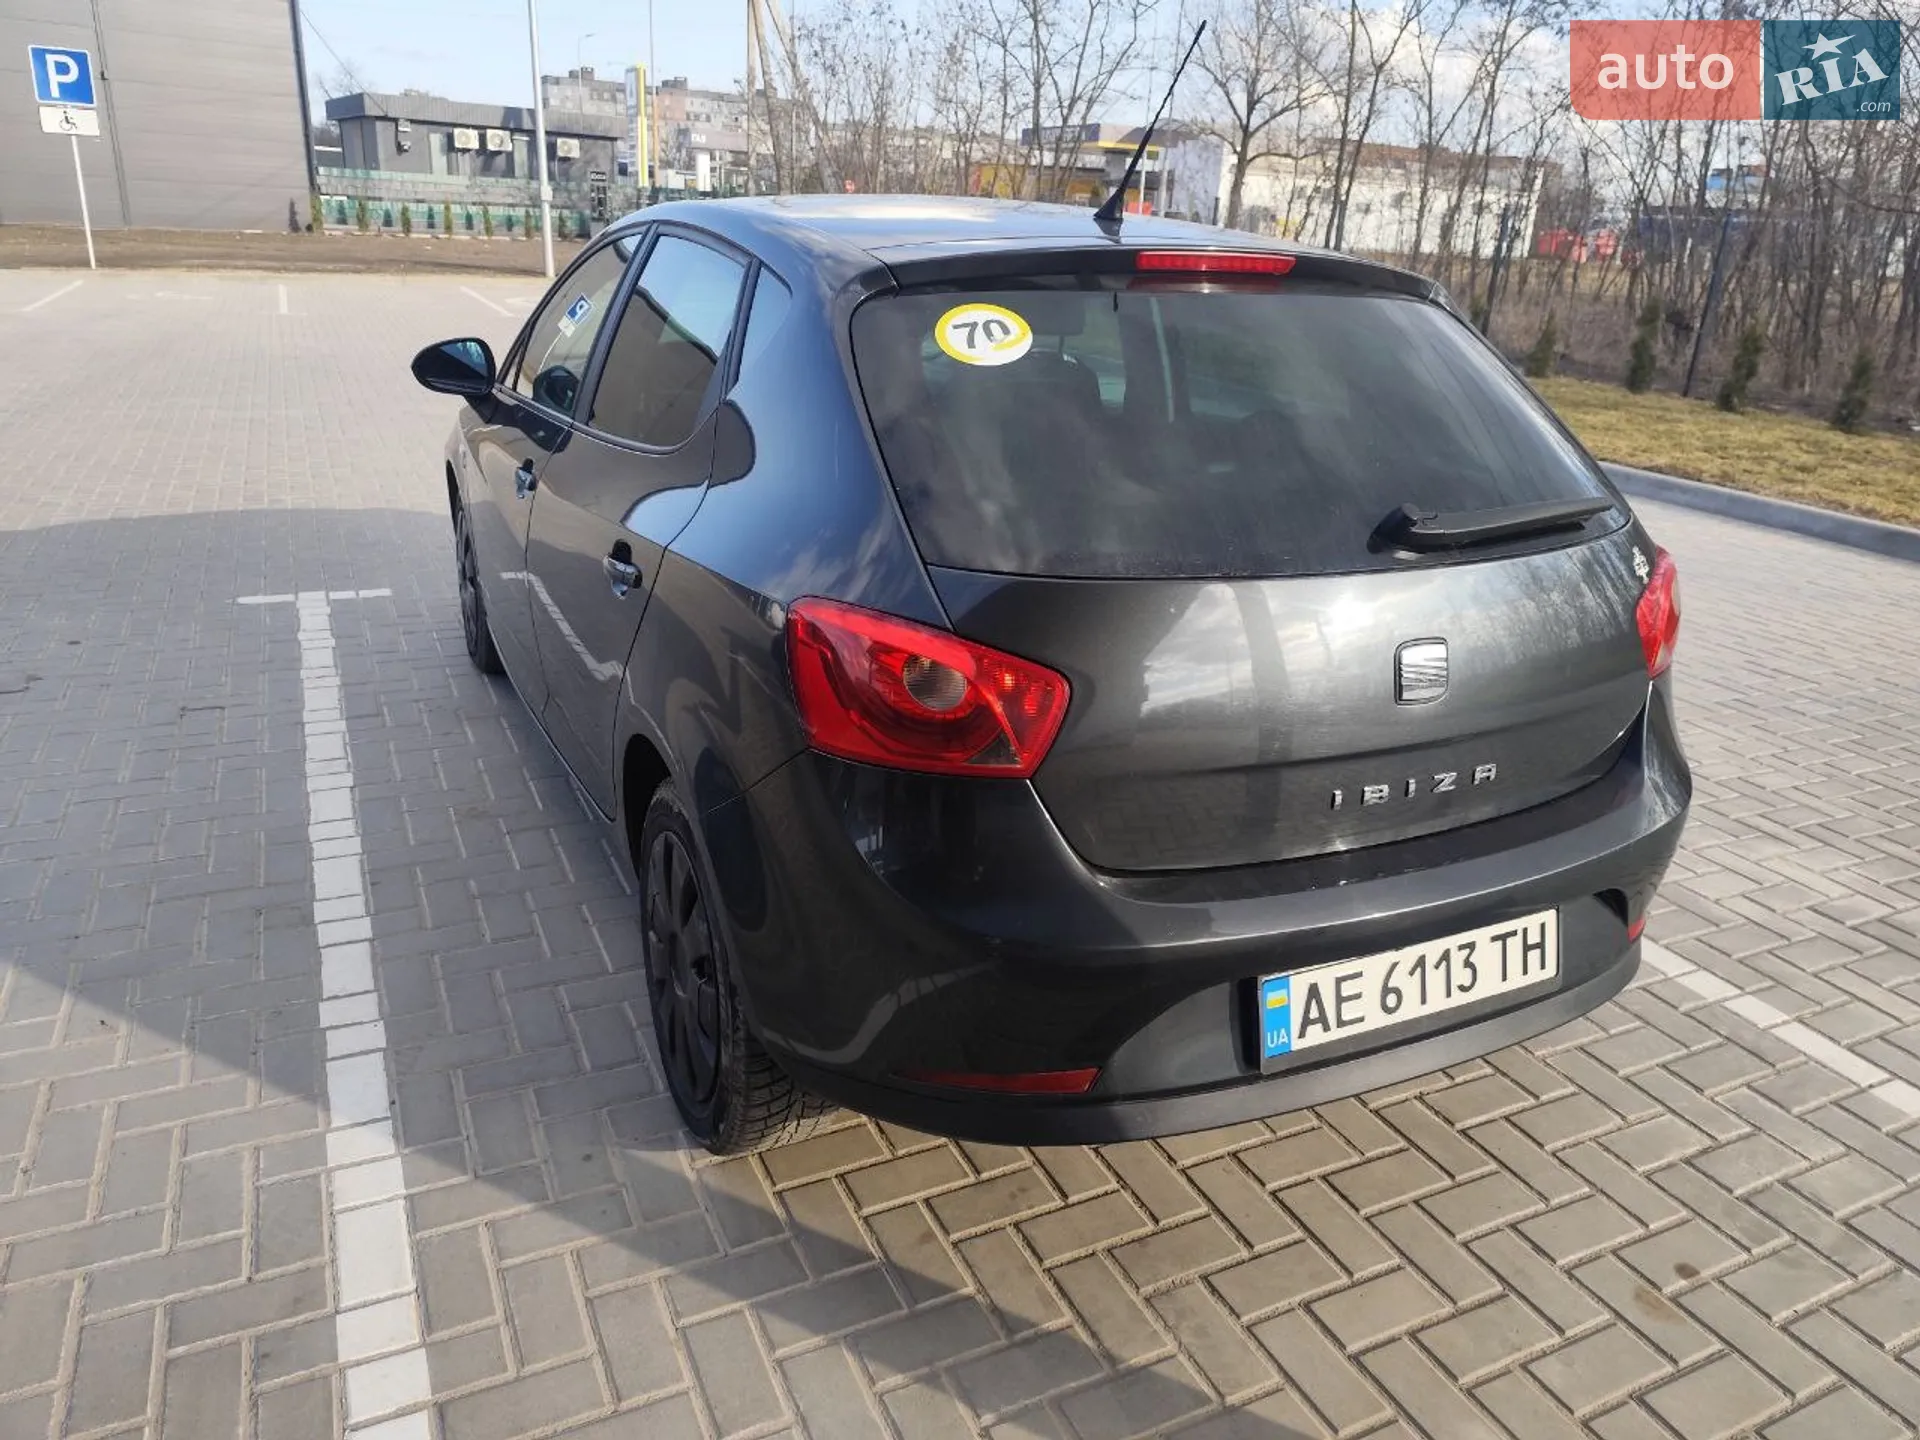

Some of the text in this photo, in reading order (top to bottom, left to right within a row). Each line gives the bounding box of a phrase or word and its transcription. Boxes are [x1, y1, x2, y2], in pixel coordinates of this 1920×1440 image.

[45, 53, 79, 98] P
[951, 318, 1011, 349] 70
[1331, 763, 1497, 811] IBIZA
[1297, 921, 1547, 1040] AE 6113 TH
[1267, 1027, 1289, 1048] UA
